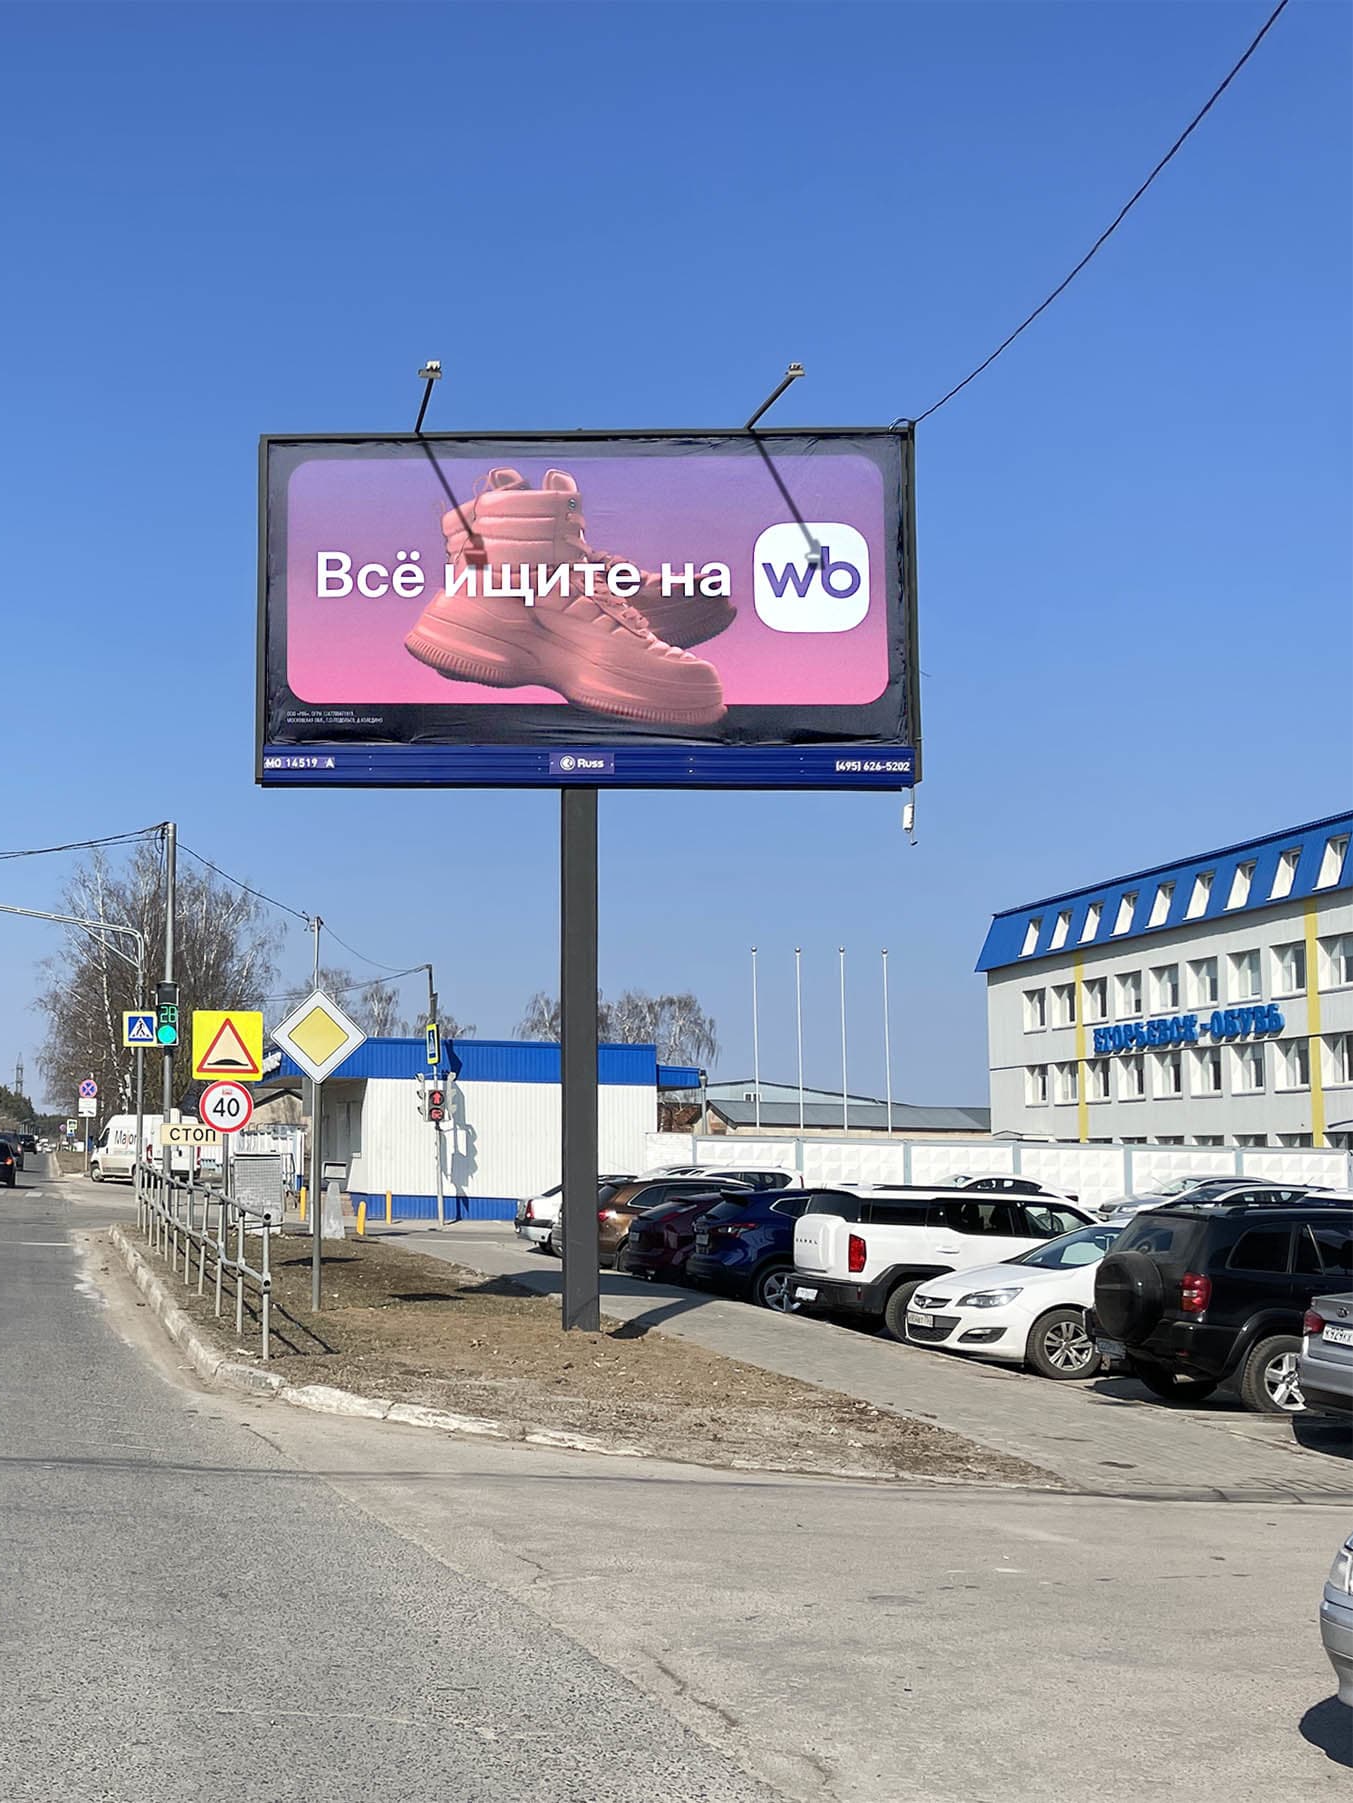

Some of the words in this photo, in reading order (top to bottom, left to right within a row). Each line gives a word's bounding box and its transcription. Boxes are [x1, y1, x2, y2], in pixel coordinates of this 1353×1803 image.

[317, 550, 425, 599] Всё
[444, 562, 641, 607] ищите
[661, 561, 732, 598] на
[762, 546, 862, 599] wb
[286, 757, 318, 769] 14519
[325, 757, 335, 769] А
[577, 758, 604, 769] Russ
[863, 761, 910, 772] 626-5202
[159, 1006, 178, 1023] 28
[212, 1097, 241, 1118] 40
[169, 1127, 216, 1142] СТОП
